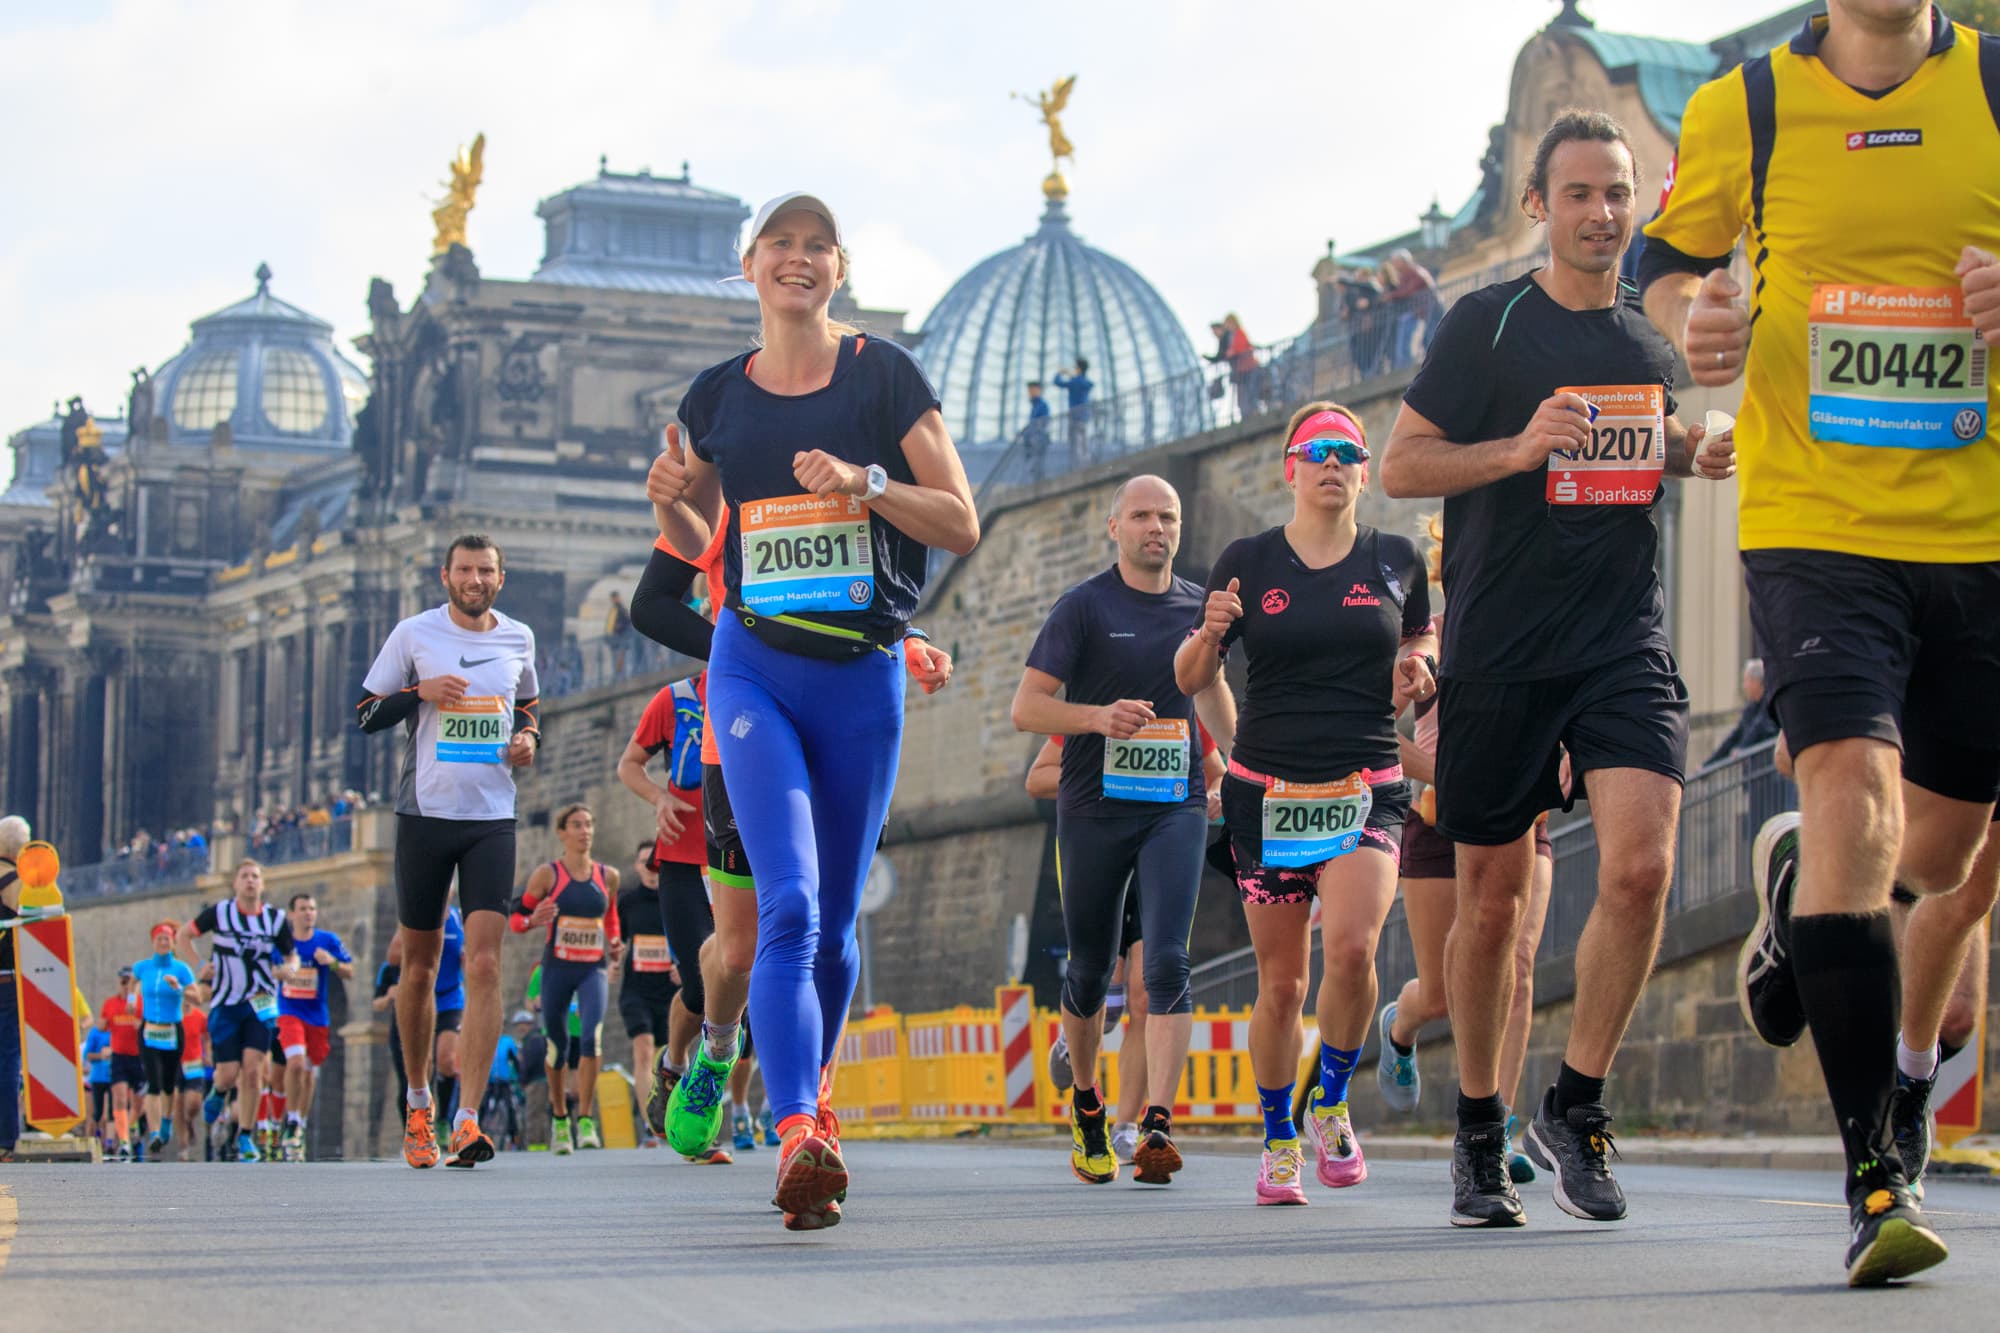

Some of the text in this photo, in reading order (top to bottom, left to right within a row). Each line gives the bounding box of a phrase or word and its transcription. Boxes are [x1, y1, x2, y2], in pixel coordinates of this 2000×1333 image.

[1867, 132, 1919, 145] lotto
[1850, 291, 1953, 309] Piepenbrock
[1828, 339, 1965, 389] 20442
[1811, 411, 1943, 431] Gläserne Manufaktur
[1573, 427, 1653, 461] 0207
[765, 498, 839, 516] Piepenbrock
[857, 525, 865, 533] C
[755, 533, 850, 575] 20691
[744, 589, 841, 606] Gläserne Manufaktur
[1342, 595, 1382, 607] Natalie
[445, 718, 500, 738] 20104
[1114, 746, 1181, 772] 20285
[1274, 804, 1358, 833] 20460
